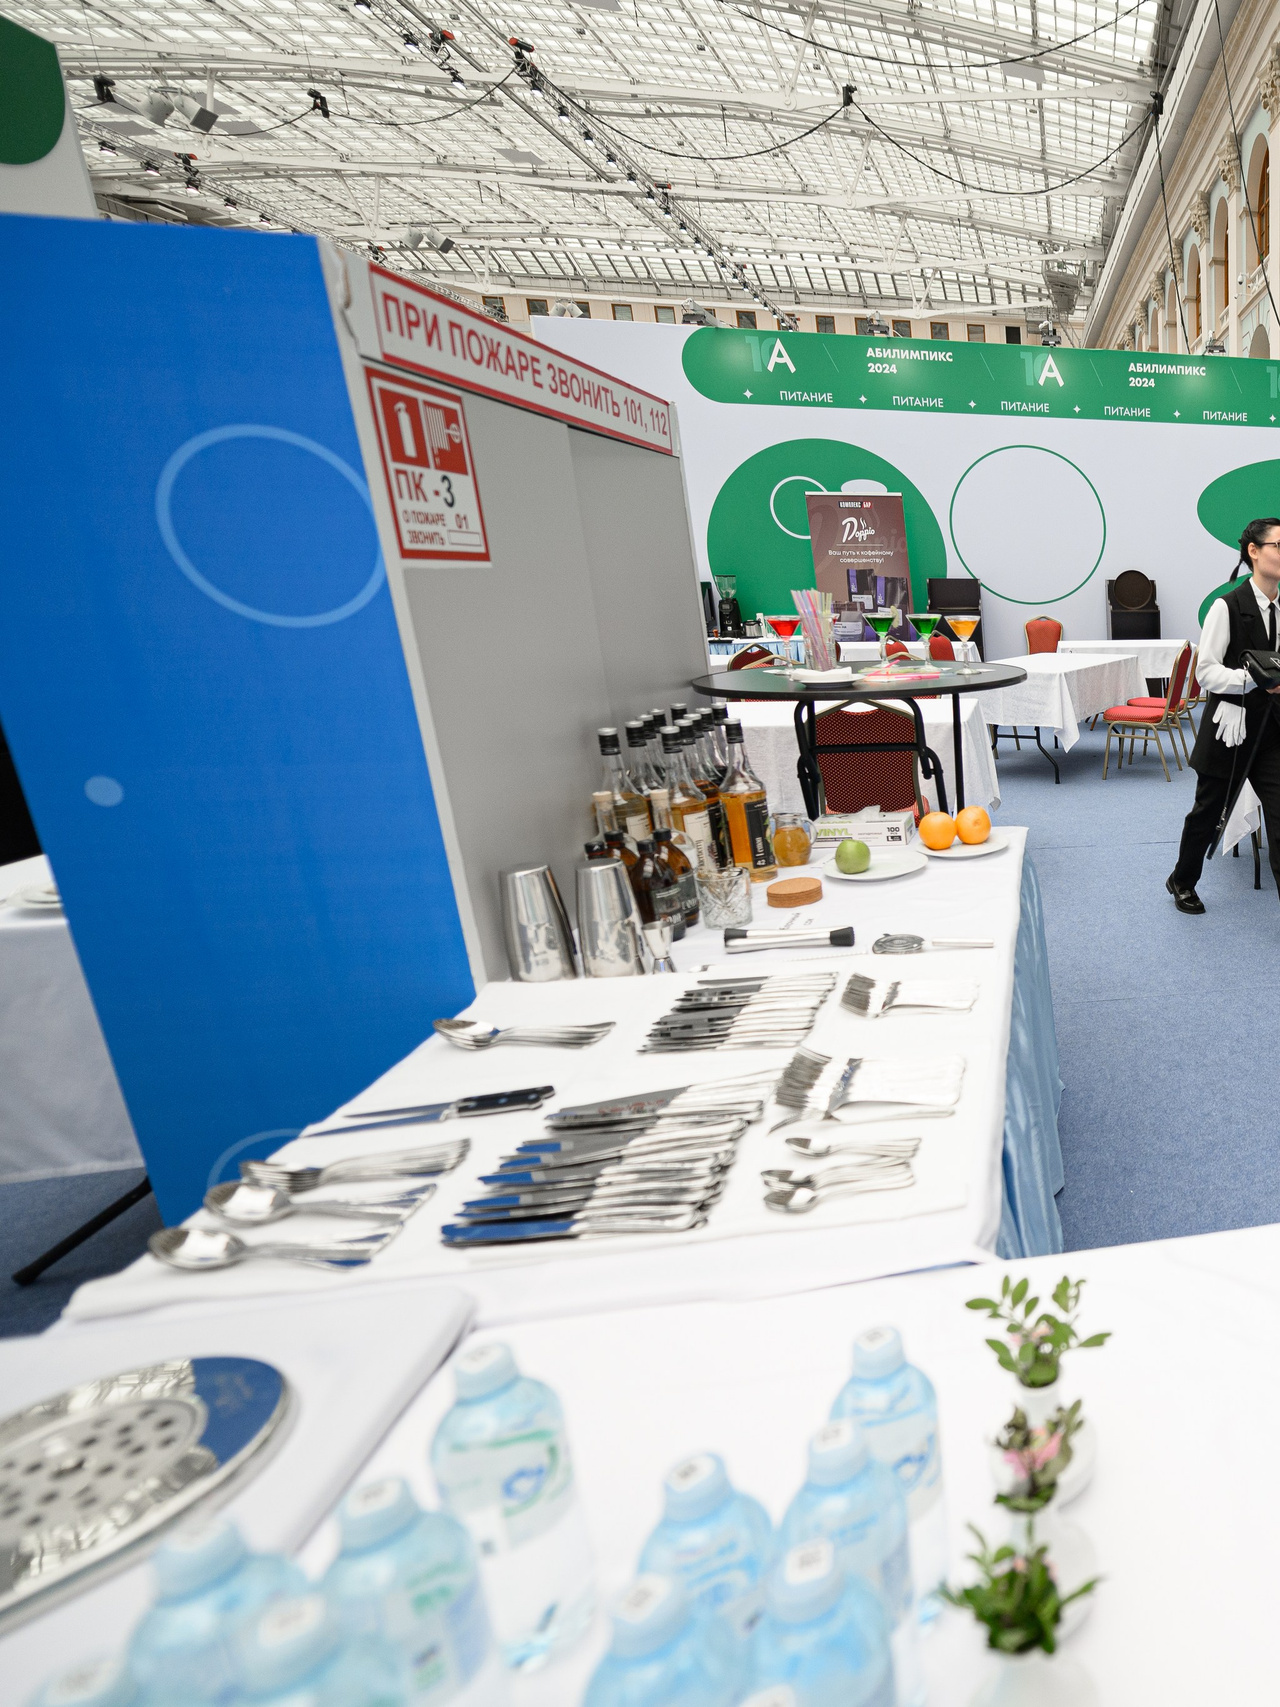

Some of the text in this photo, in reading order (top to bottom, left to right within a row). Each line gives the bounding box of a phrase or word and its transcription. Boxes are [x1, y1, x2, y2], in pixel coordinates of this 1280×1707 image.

[382, 291, 668, 436] ПРИ ПОЖАРЕ ЗВОНИТЬ 101, 112
[866, 346, 953, 363] АБИЛИМПИКС
[867, 363, 897, 374] 2024
[1128, 362, 1206, 376] АБИЛИМПИКС
[1129, 377, 1155, 388] 2024
[779, 390, 834, 404] ПИТАНИЕ
[892, 395, 944, 408] ПИТАНИЕ
[1000, 400, 1050, 413] ПИТАНИЕ
[1104, 406, 1151, 418] ПИТАНИЕ
[1202, 410, 1248, 422] ПИТАНИЕ
[394, 468, 428, 502] ПК
[412, 510, 446, 527] ПОЖАРЕ
[455, 513, 469, 530] 01
[842, 517, 875, 543] Doppio
